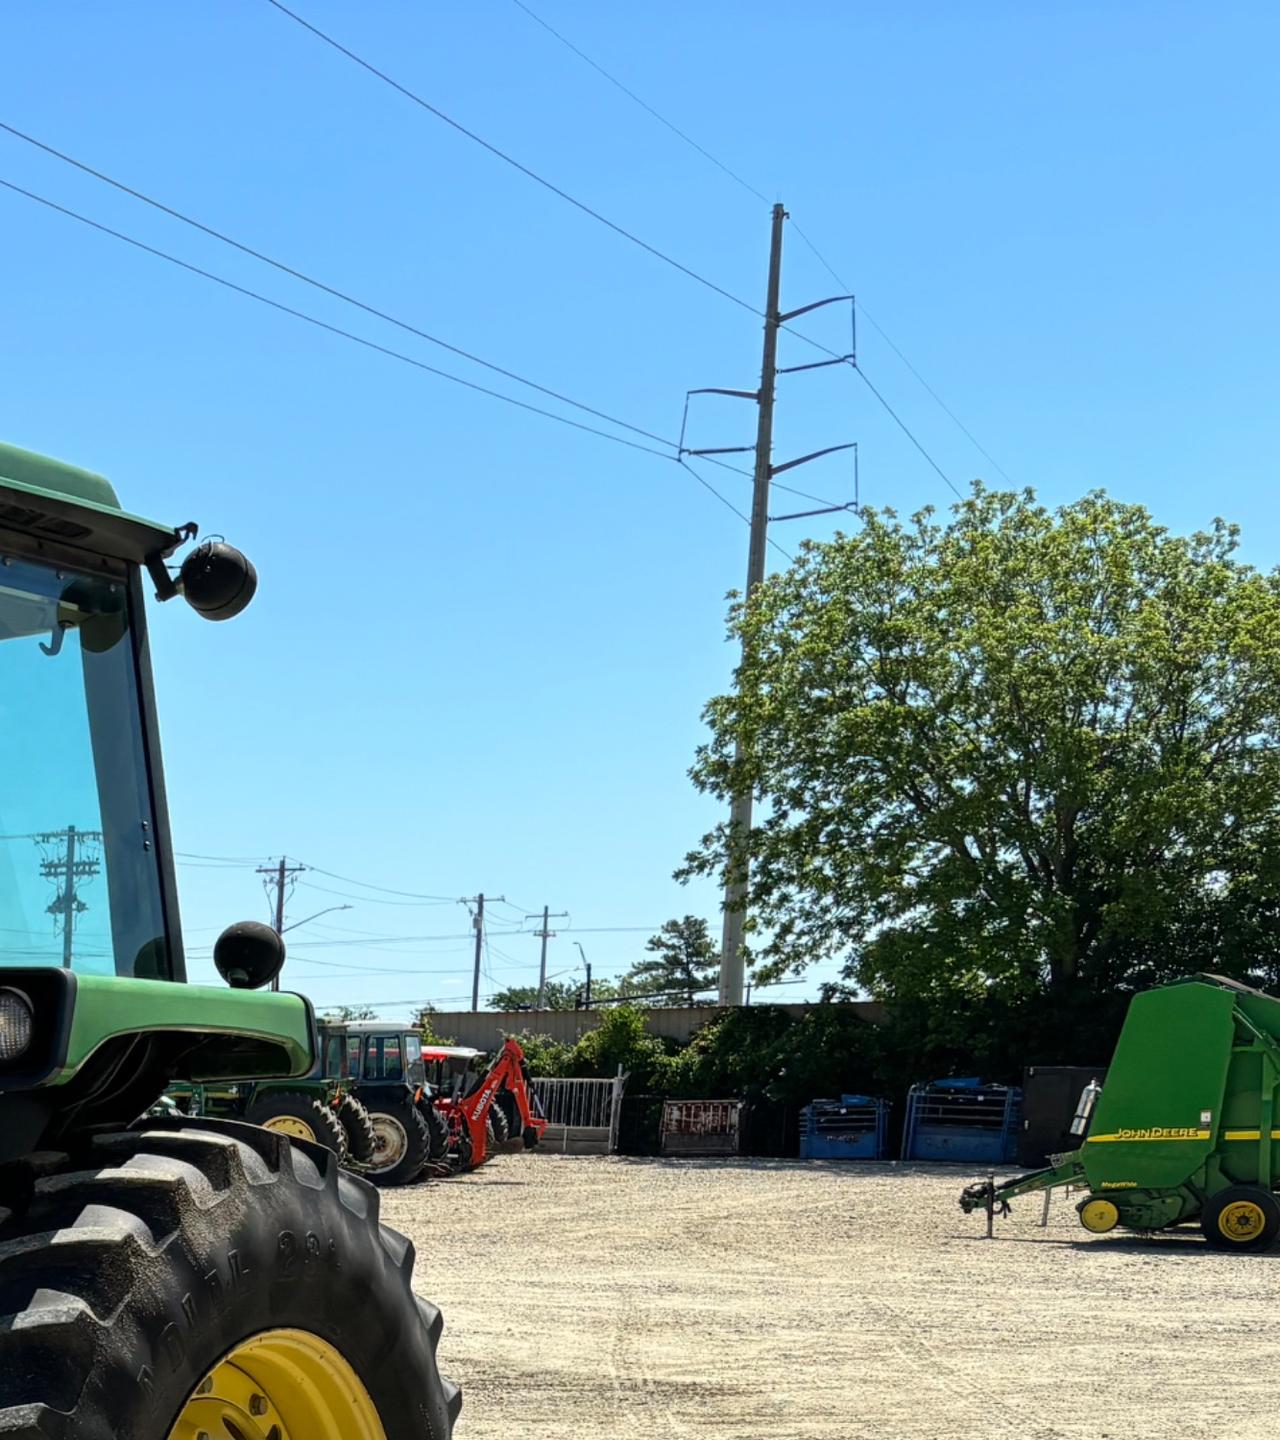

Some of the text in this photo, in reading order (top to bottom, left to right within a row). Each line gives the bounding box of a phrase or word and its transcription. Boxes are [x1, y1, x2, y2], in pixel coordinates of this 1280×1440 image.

[471, 1089, 491, 1120] KUBOTA
[1114, 1127, 1198, 1138] JOHN DEERE
